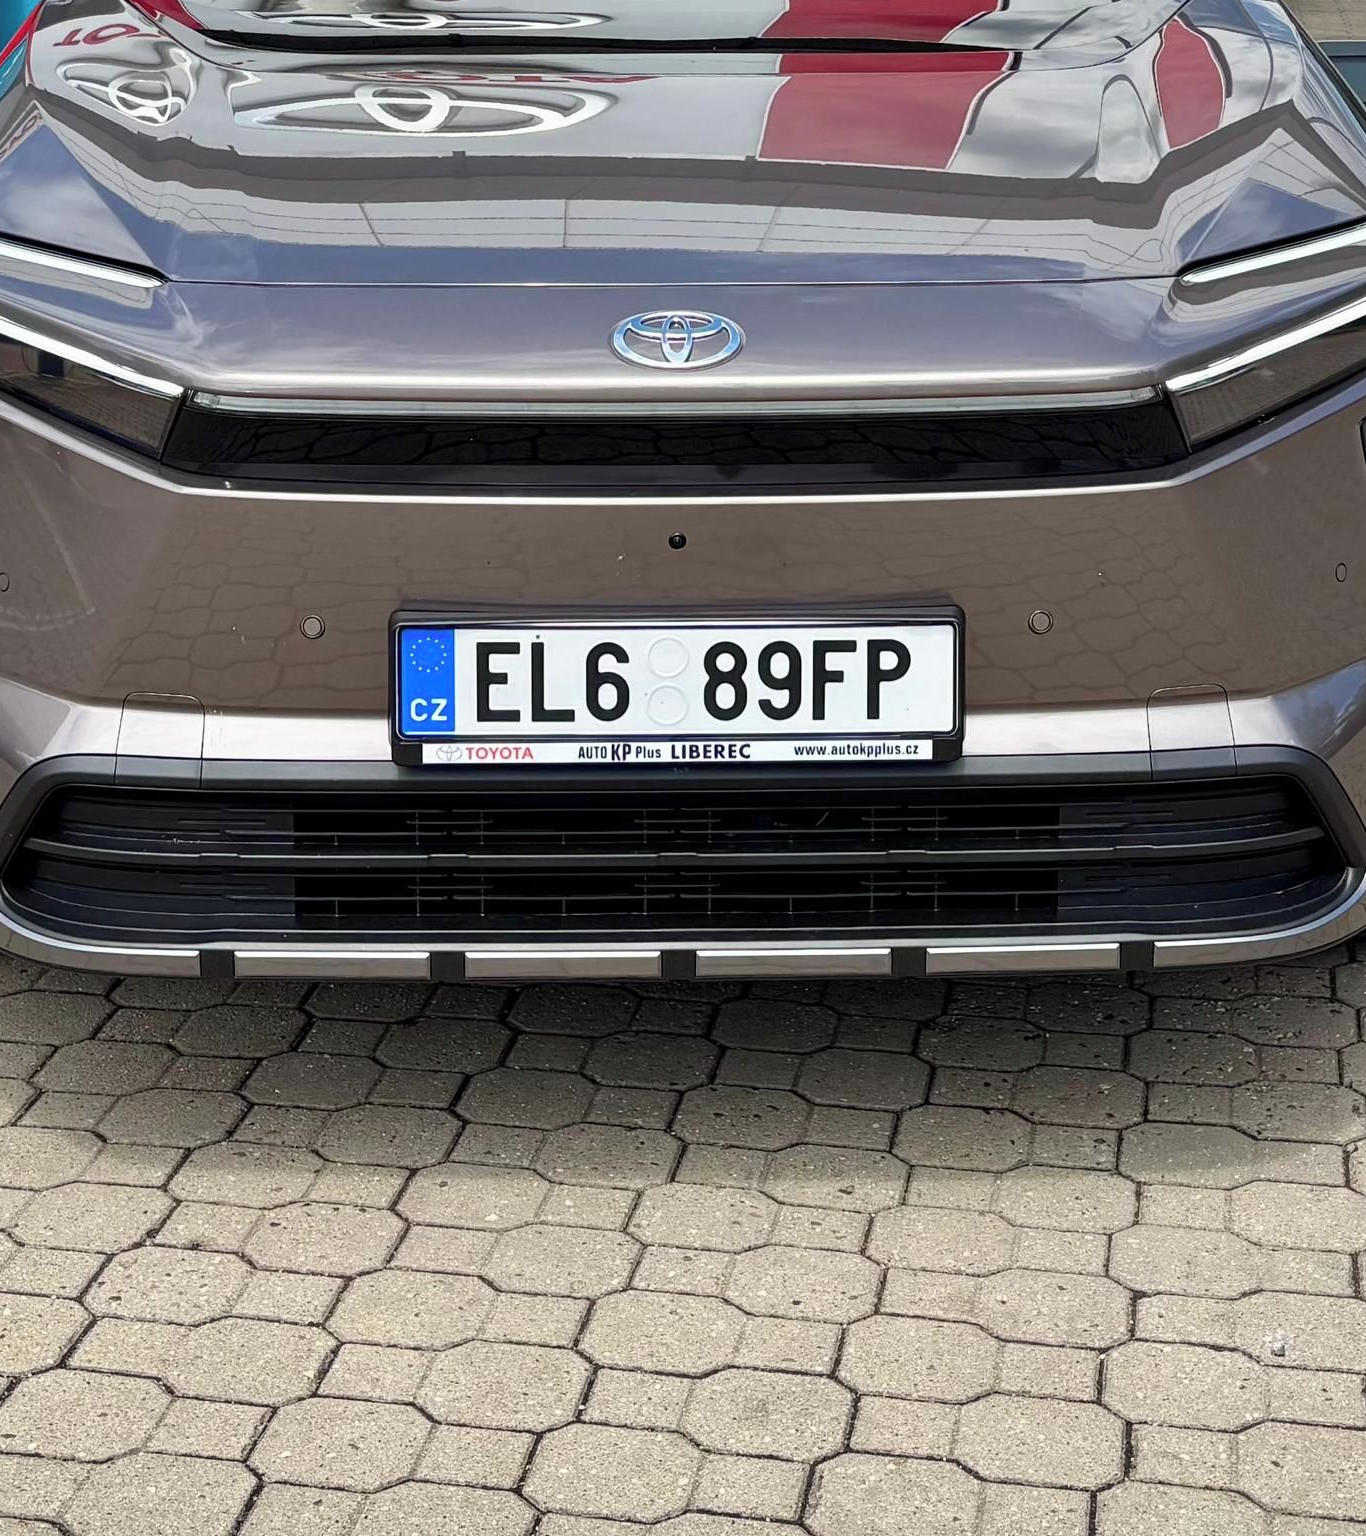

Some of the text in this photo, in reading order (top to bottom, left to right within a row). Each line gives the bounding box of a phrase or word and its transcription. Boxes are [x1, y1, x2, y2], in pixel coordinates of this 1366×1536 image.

[475, 638, 912, 723] EL6 89FP
[409, 698, 448, 723] CZ
[465, 742, 919, 762] TOYOTA AUTO KP Plus LIBEREC www.autokpplus.cz
